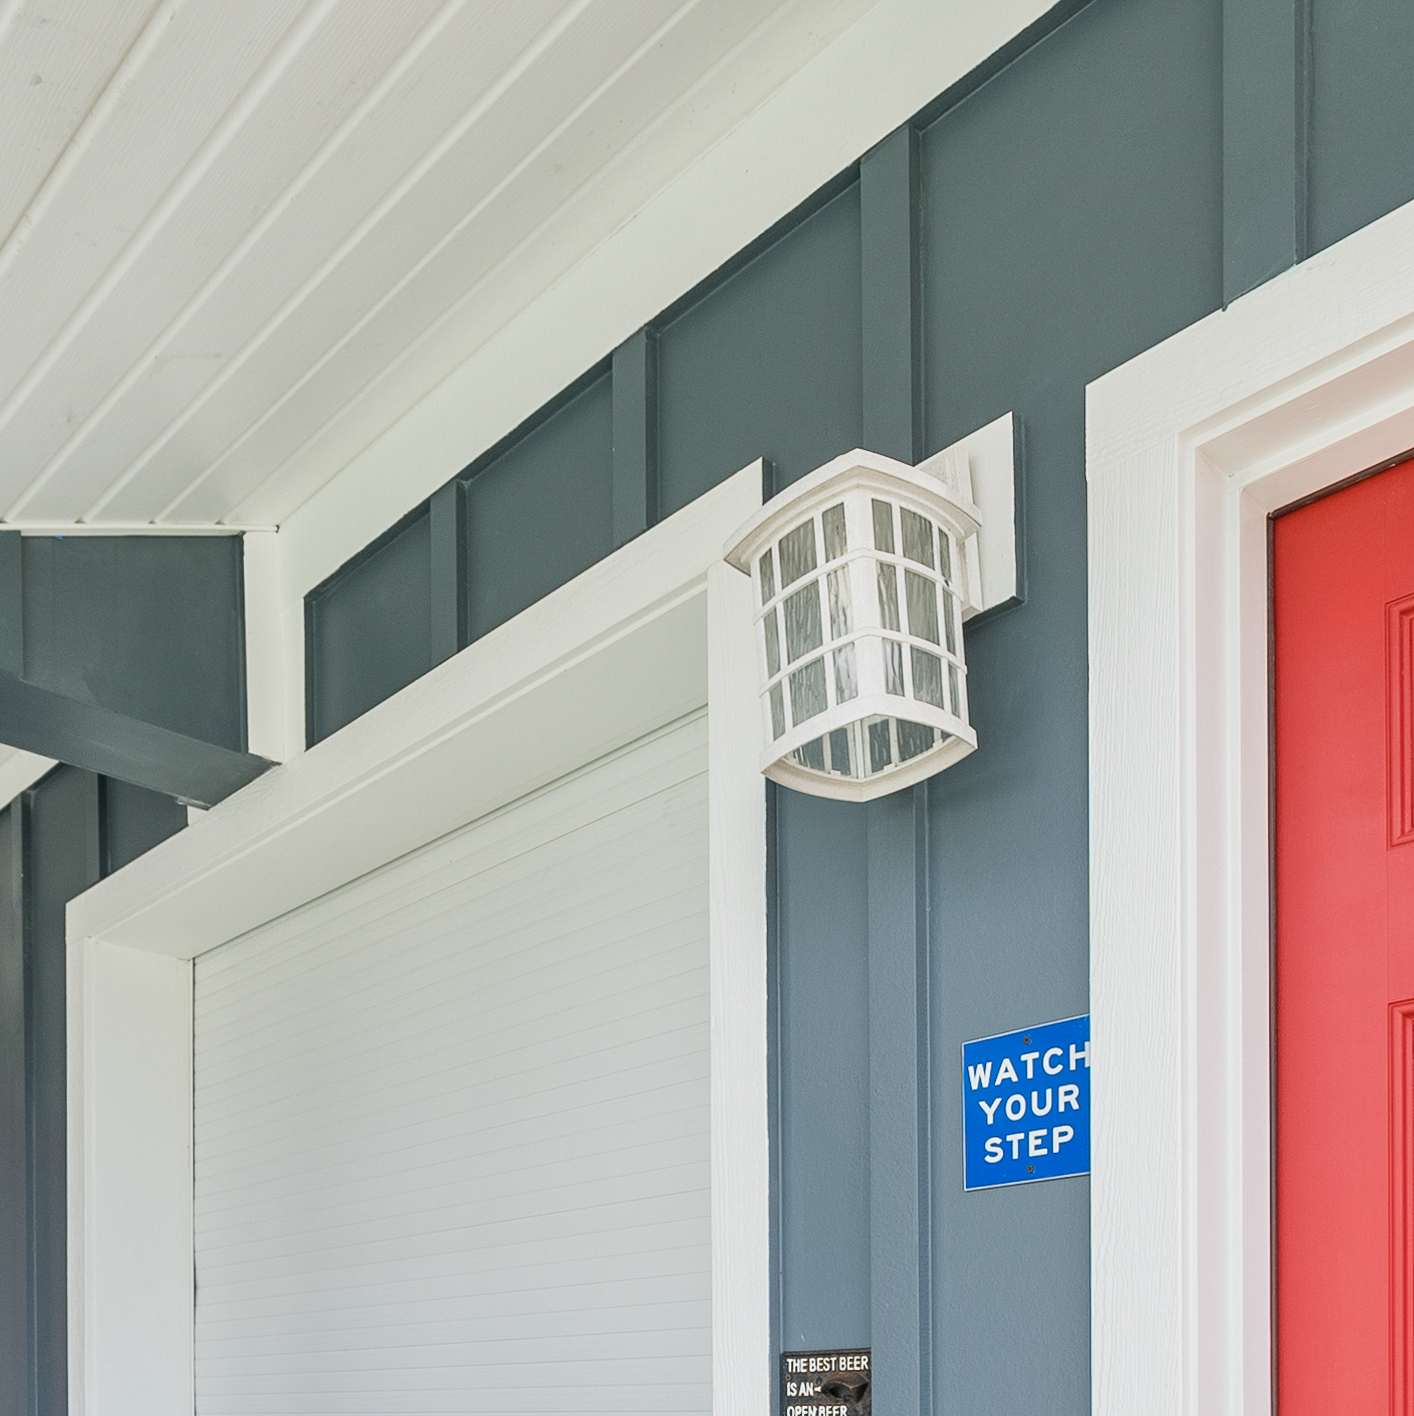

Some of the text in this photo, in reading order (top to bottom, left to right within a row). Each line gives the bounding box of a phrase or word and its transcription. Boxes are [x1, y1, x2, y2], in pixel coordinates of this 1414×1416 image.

[968, 1041, 1090, 1090] WATCH
[978, 1084, 1080, 1125] YOUR
[984, 1125, 1074, 1163] STEP
[787, 1355, 869, 1373] THE BEST BEER
[787, 1382, 814, 1397] IS AN
